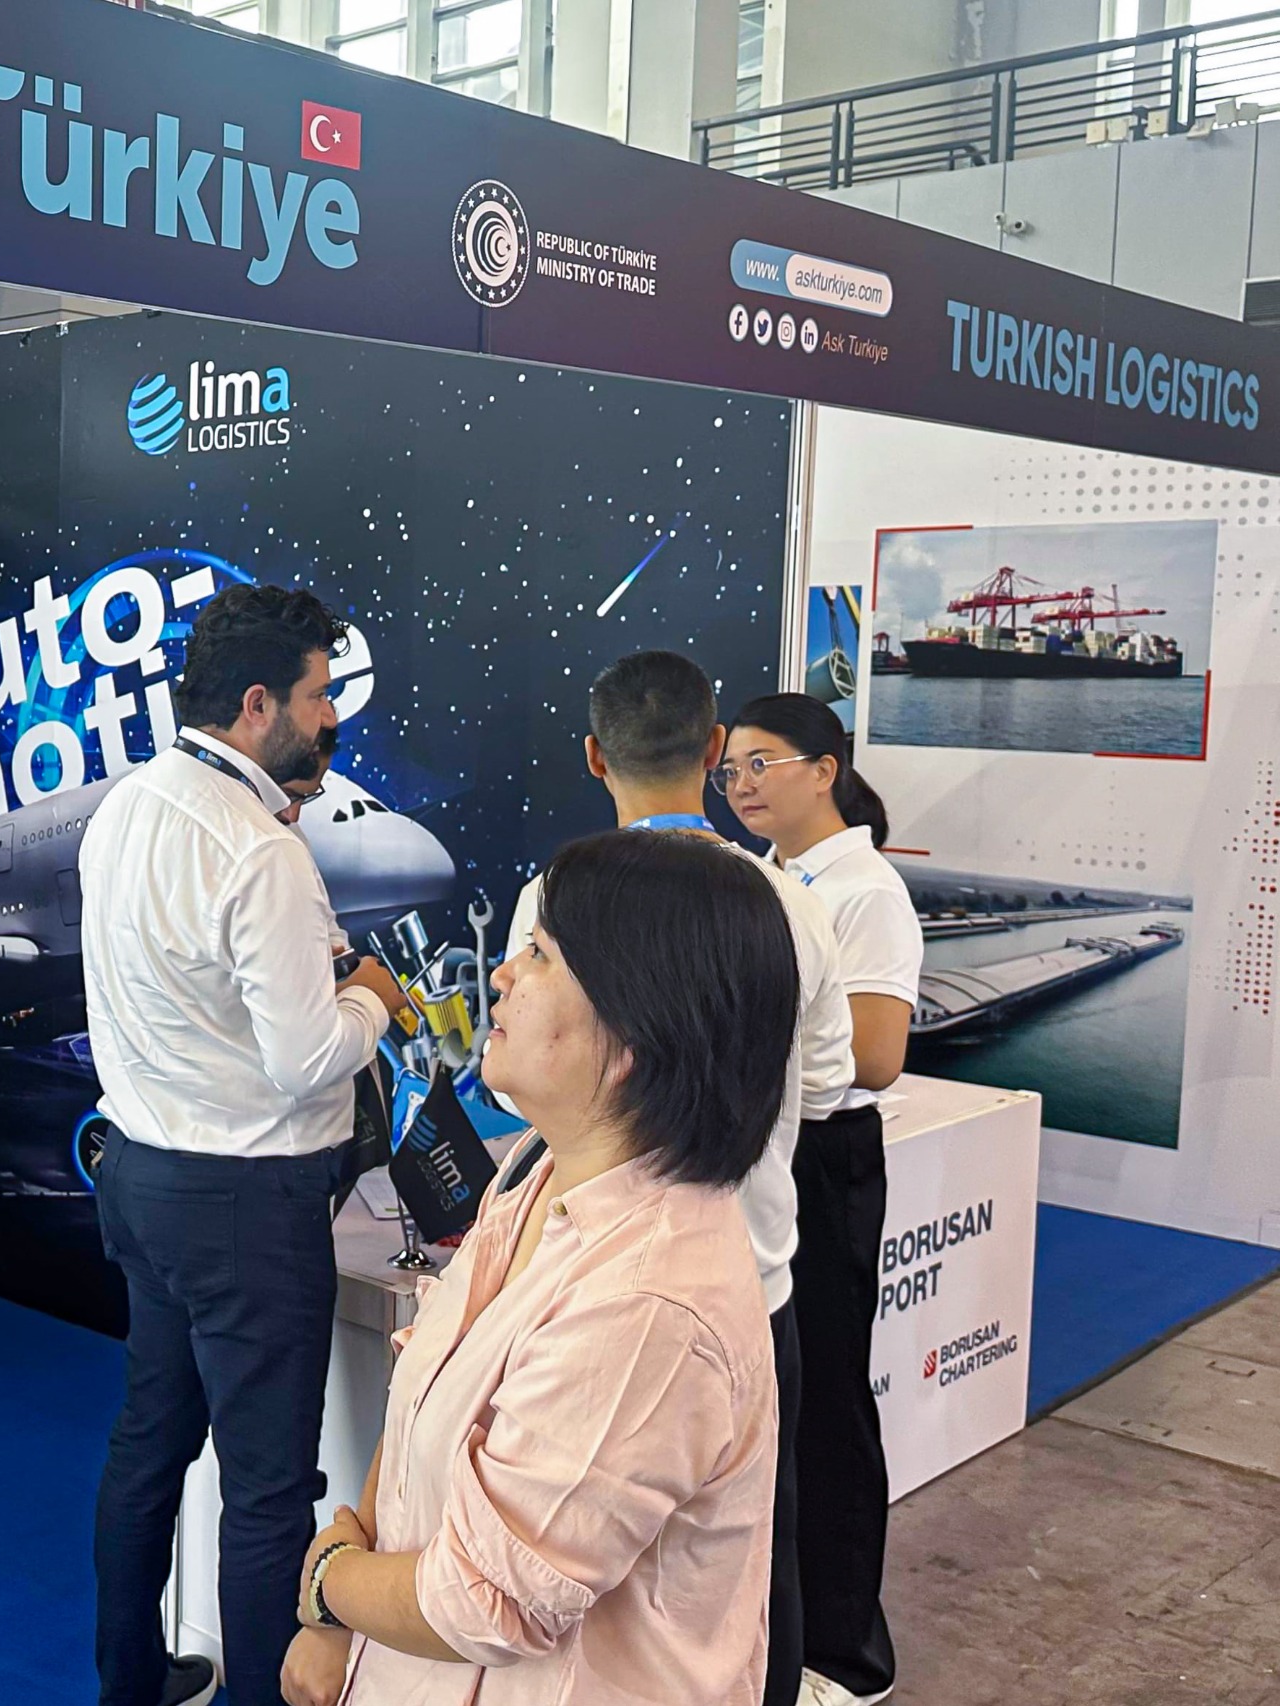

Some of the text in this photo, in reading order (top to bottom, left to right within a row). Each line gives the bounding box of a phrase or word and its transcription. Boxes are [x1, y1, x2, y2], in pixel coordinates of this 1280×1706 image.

[536, 231, 657, 271] REPUBLIC OF TÜRKİYE
[536, 256, 656, 296] MINISTRY OF TRADE
[746, 259, 883, 304] www. askturkiye.com
[820, 330, 845, 354] Ask
[848, 334, 889, 364] Turkiye
[946, 299, 1260, 431] TURKISH LOGISTICS
[189, 360, 290, 421] lima
[188, 417, 290, 453] LOGISTICS
[428, 1140, 470, 1204] lima
[882, 1199, 993, 1274] BORUSAN
[880, 1261, 943, 1321] PORT
[939, 1320, 1001, 1365] BORUSAN
[939, 1334, 1018, 1387] CHARTERING
